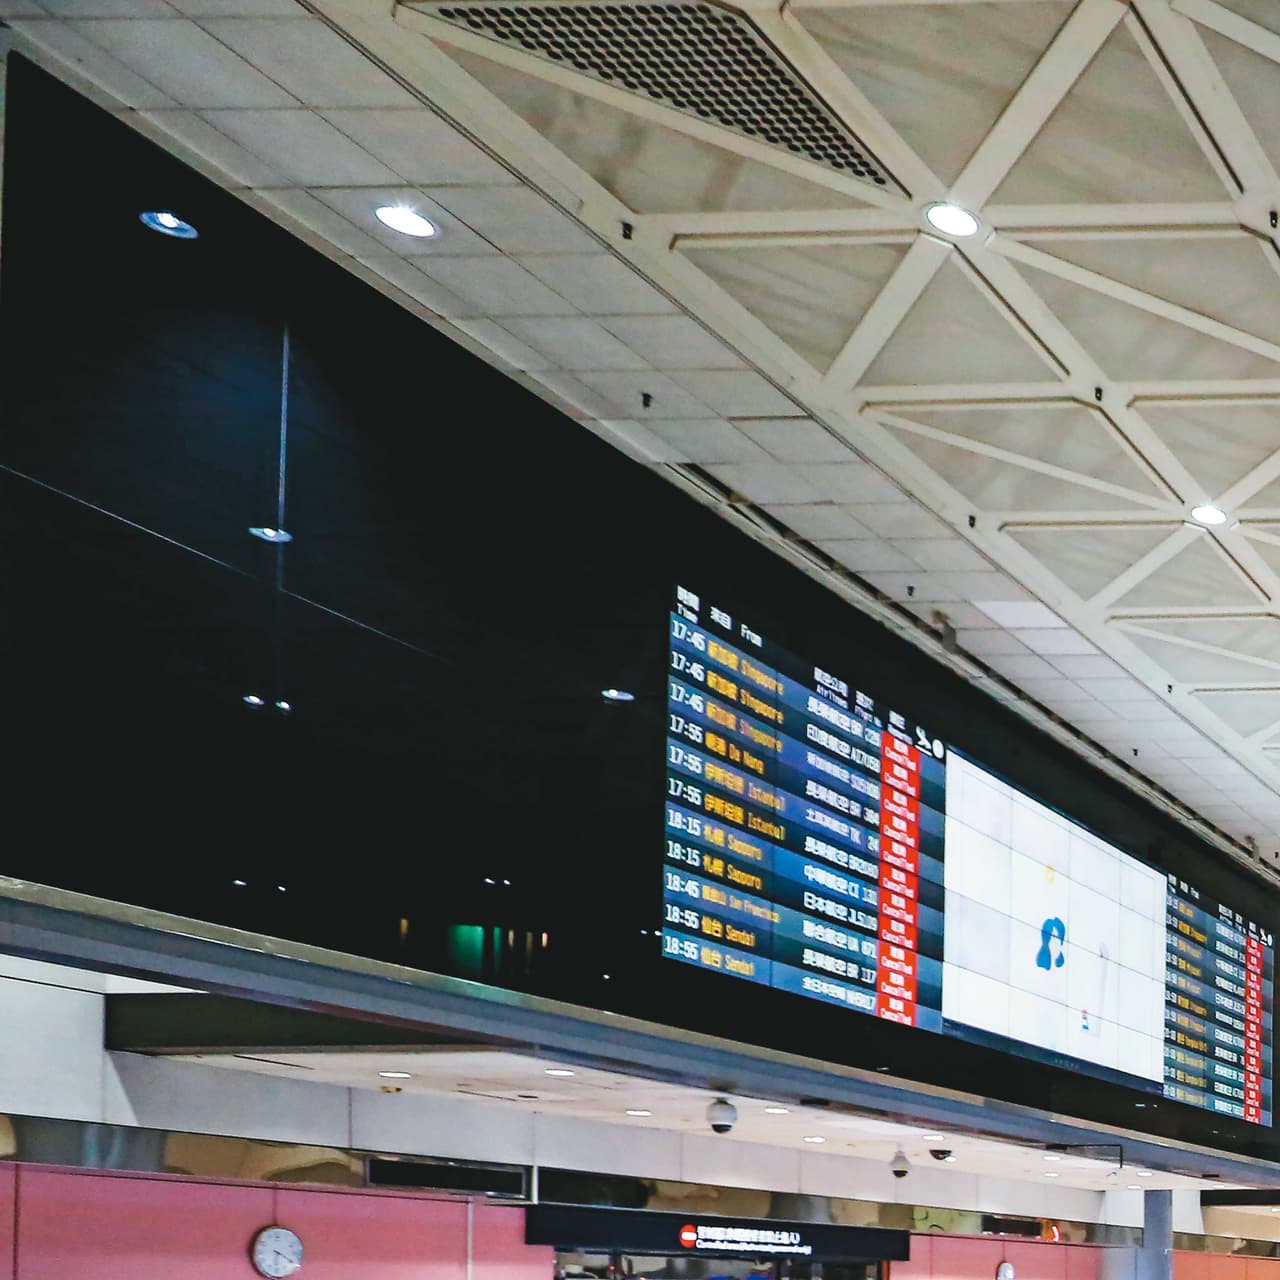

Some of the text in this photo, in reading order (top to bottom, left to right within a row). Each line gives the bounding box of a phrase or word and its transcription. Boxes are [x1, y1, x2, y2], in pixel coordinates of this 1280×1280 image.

[670, 714, 703, 743] 17:55
[669, 745, 703, 774] 17:55
[668, 778, 702, 805] 17:55
[668, 809, 701, 836] 18:15
[667, 840, 701, 867] 18:15
[665, 904, 699, 929] 18:55
[665, 935, 699, 960] 18:55
